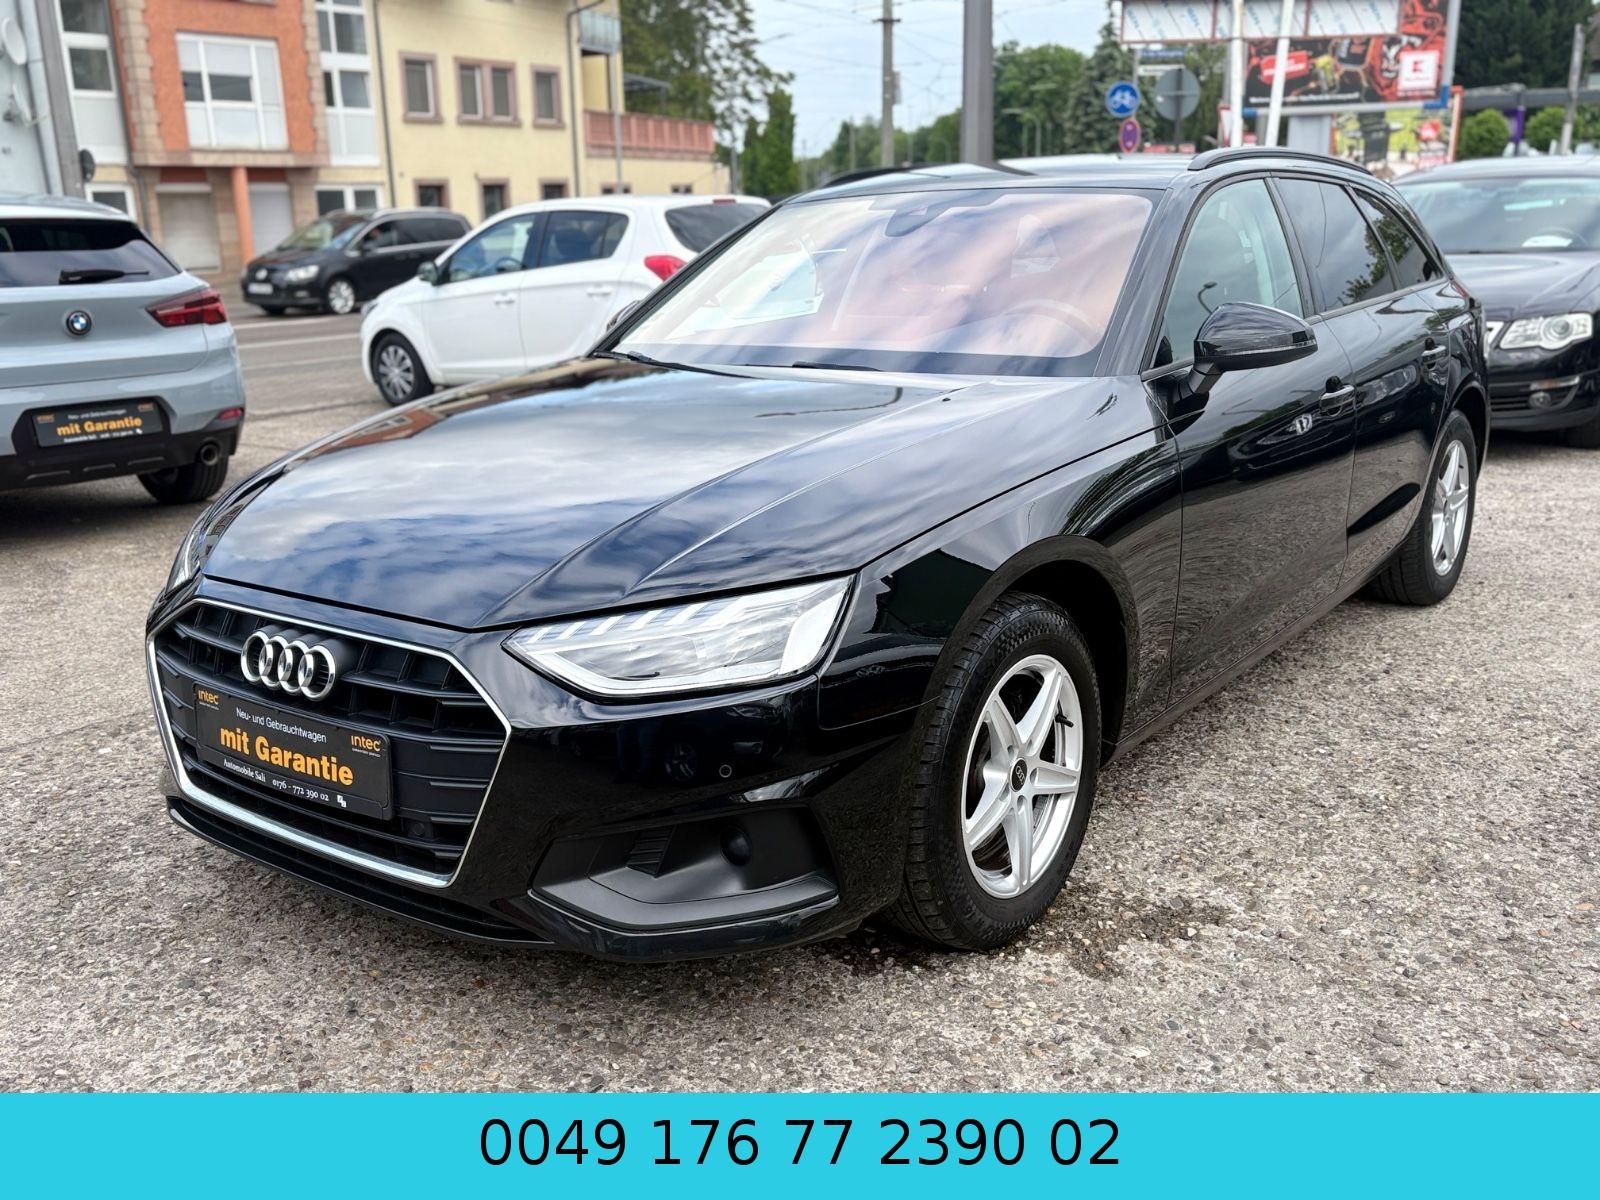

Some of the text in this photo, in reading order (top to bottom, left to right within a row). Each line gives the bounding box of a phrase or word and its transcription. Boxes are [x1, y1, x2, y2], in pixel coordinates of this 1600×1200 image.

[57, 422, 81, 436] mit
[83, 416, 143, 433] Garantie
[198, 689, 219, 705] intec
[236, 707, 327, 743] Neu- und Gebrauchtwagen
[220, 727, 354, 786] mit Garantie
[350, 735, 381, 752] intec
[223, 758, 254, 778] Automobile
[254, 770, 266, 782] Sali
[272, 779, 287, 790] 0176
[292, 785, 305, 794] 772
[306, 789, 319, 799] 390
[320, 793, 329, 802] 02
